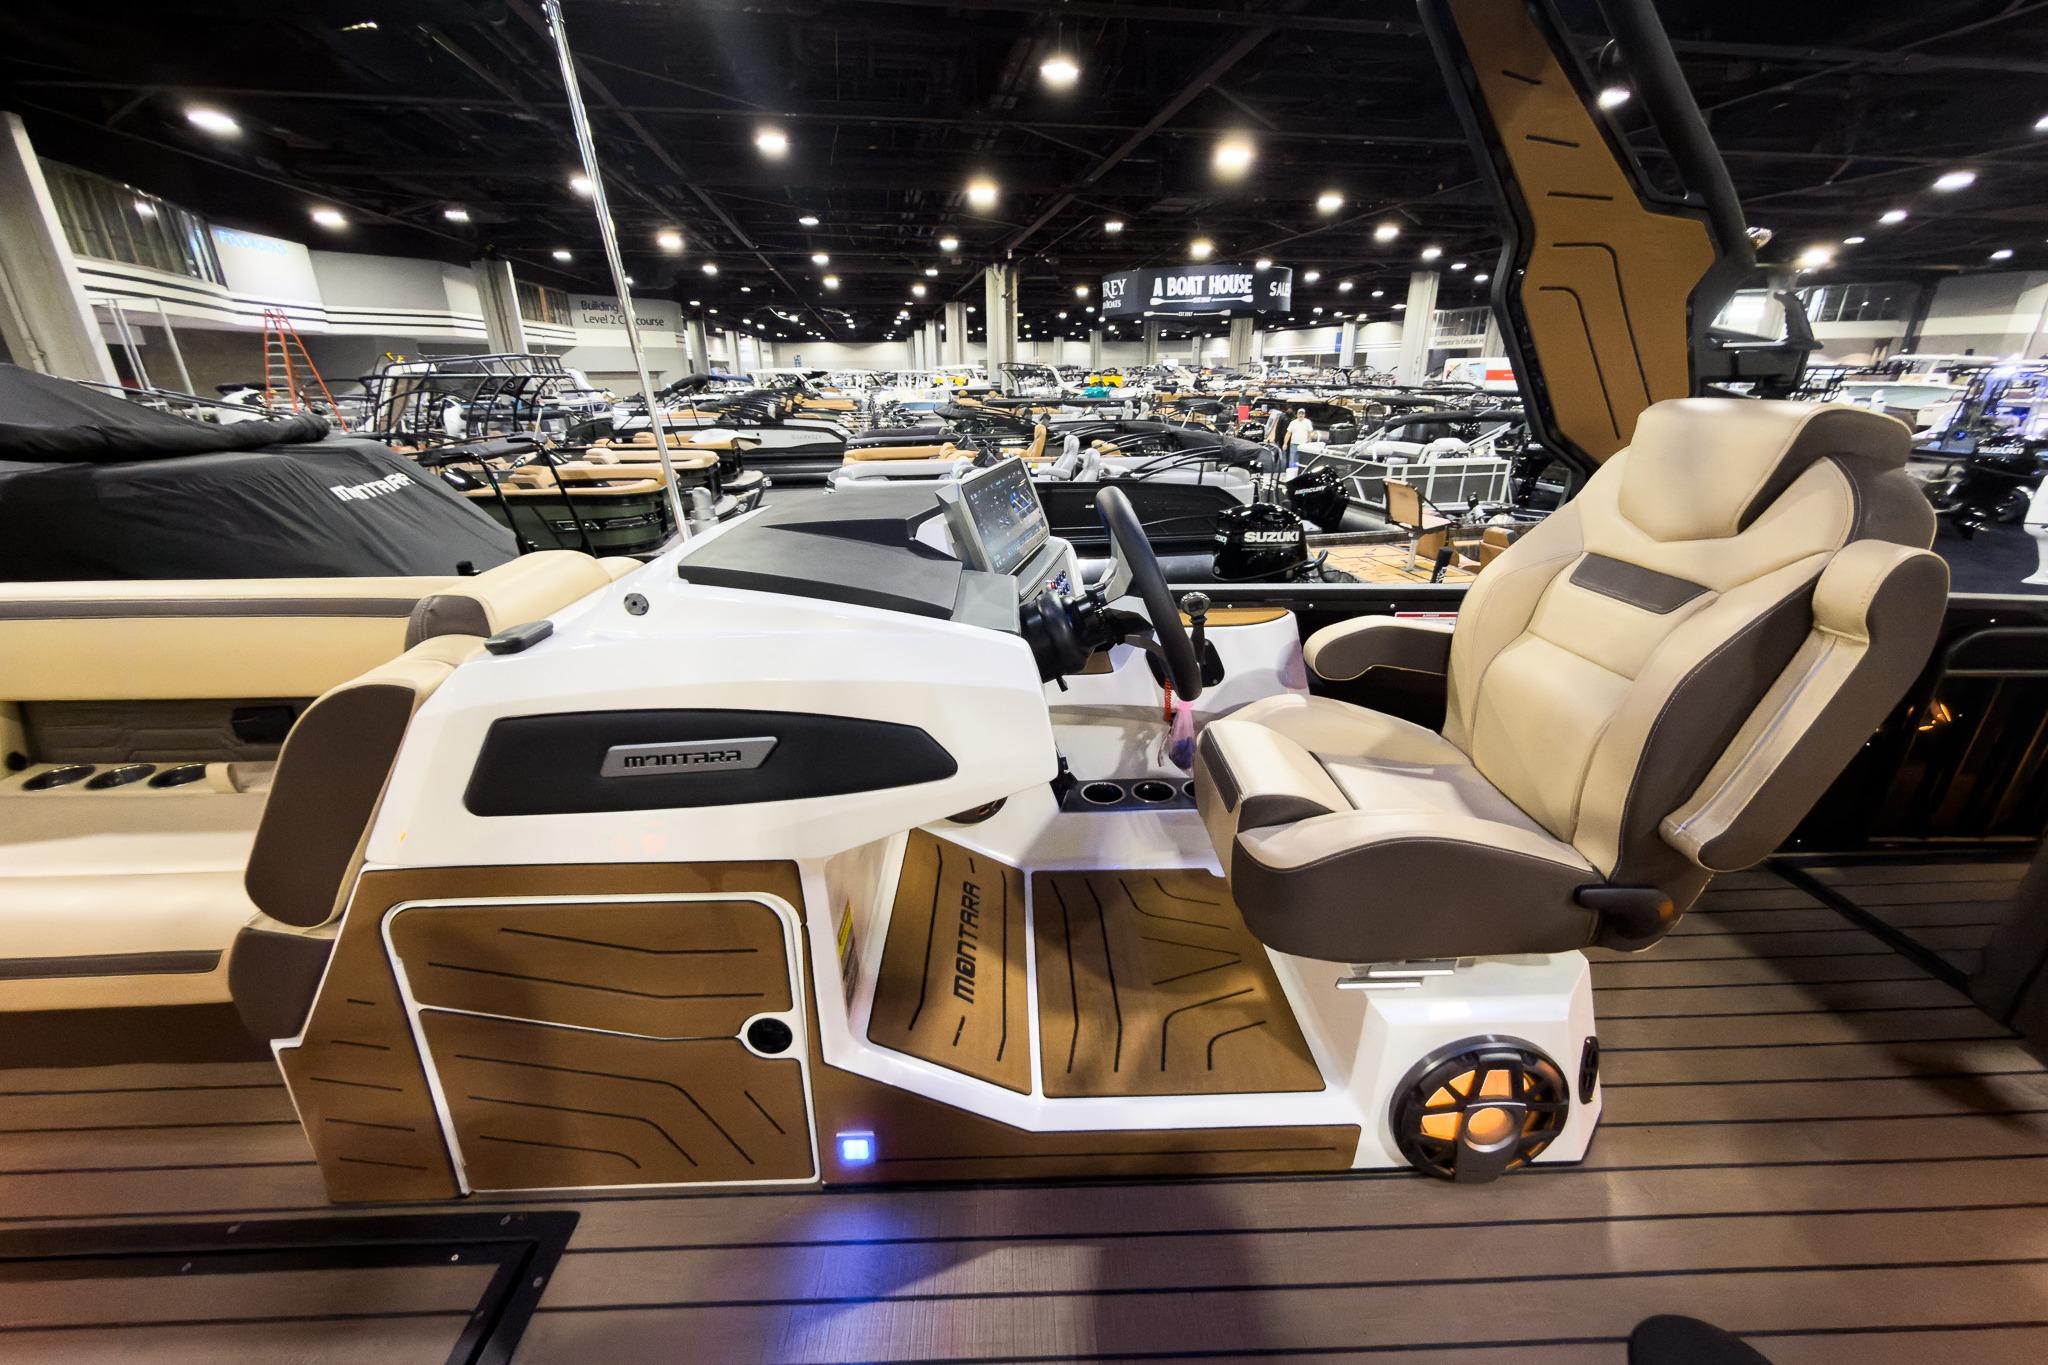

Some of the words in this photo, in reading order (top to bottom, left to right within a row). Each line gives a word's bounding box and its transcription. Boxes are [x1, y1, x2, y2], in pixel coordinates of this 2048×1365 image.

[1152, 277, 1163, 296] A
[1166, 275, 1205, 297] BOAT
[1208, 274, 1254, 295] HOUSE
[581, 300, 619, 314] Building
[583, 314, 608, 324] Level
[610, 314, 617, 324] 2
[617, 315, 664, 326] Ccourse
[1244, 531, 1300, 543] SUZUKI
[953, 881, 981, 1005] MONTARA
